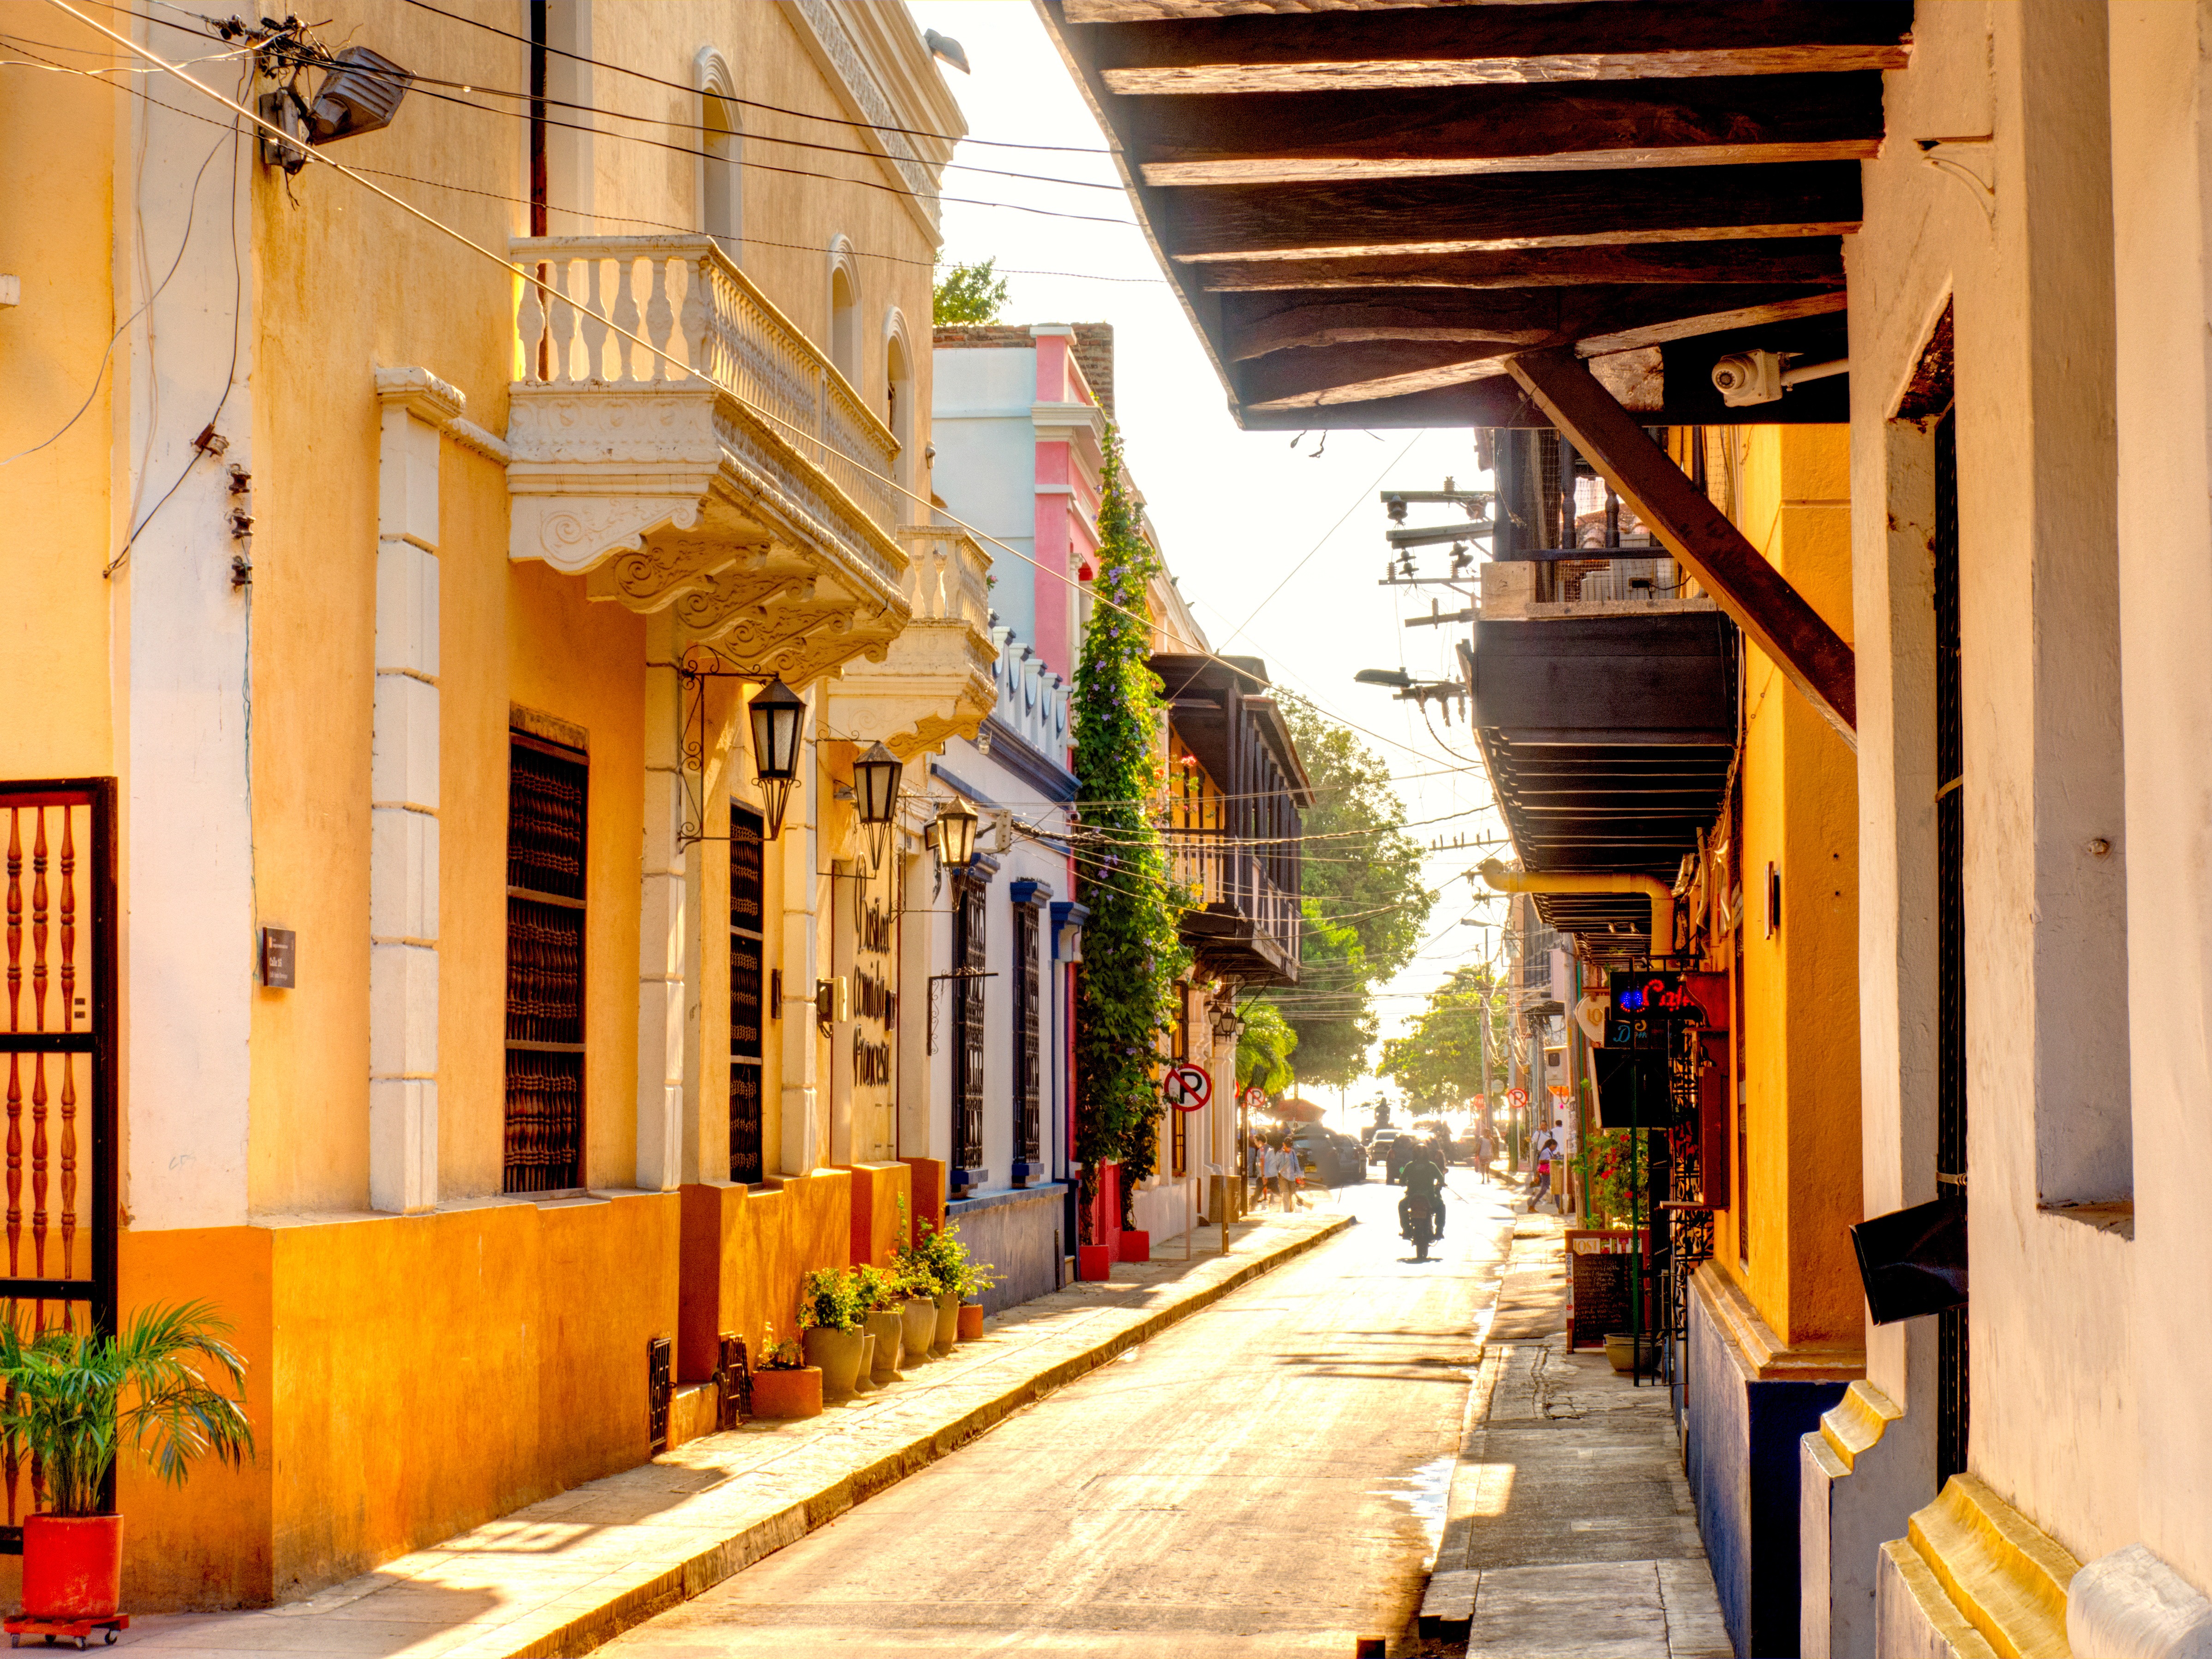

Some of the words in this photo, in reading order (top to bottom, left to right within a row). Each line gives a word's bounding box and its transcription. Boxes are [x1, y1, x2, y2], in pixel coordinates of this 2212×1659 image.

[854, 960, 885, 1021] Comida
[853, 1024, 890, 1087] Francesa
[1180, 1071, 1202, 1104] P
[1514, 1091, 1523, 1105] P
